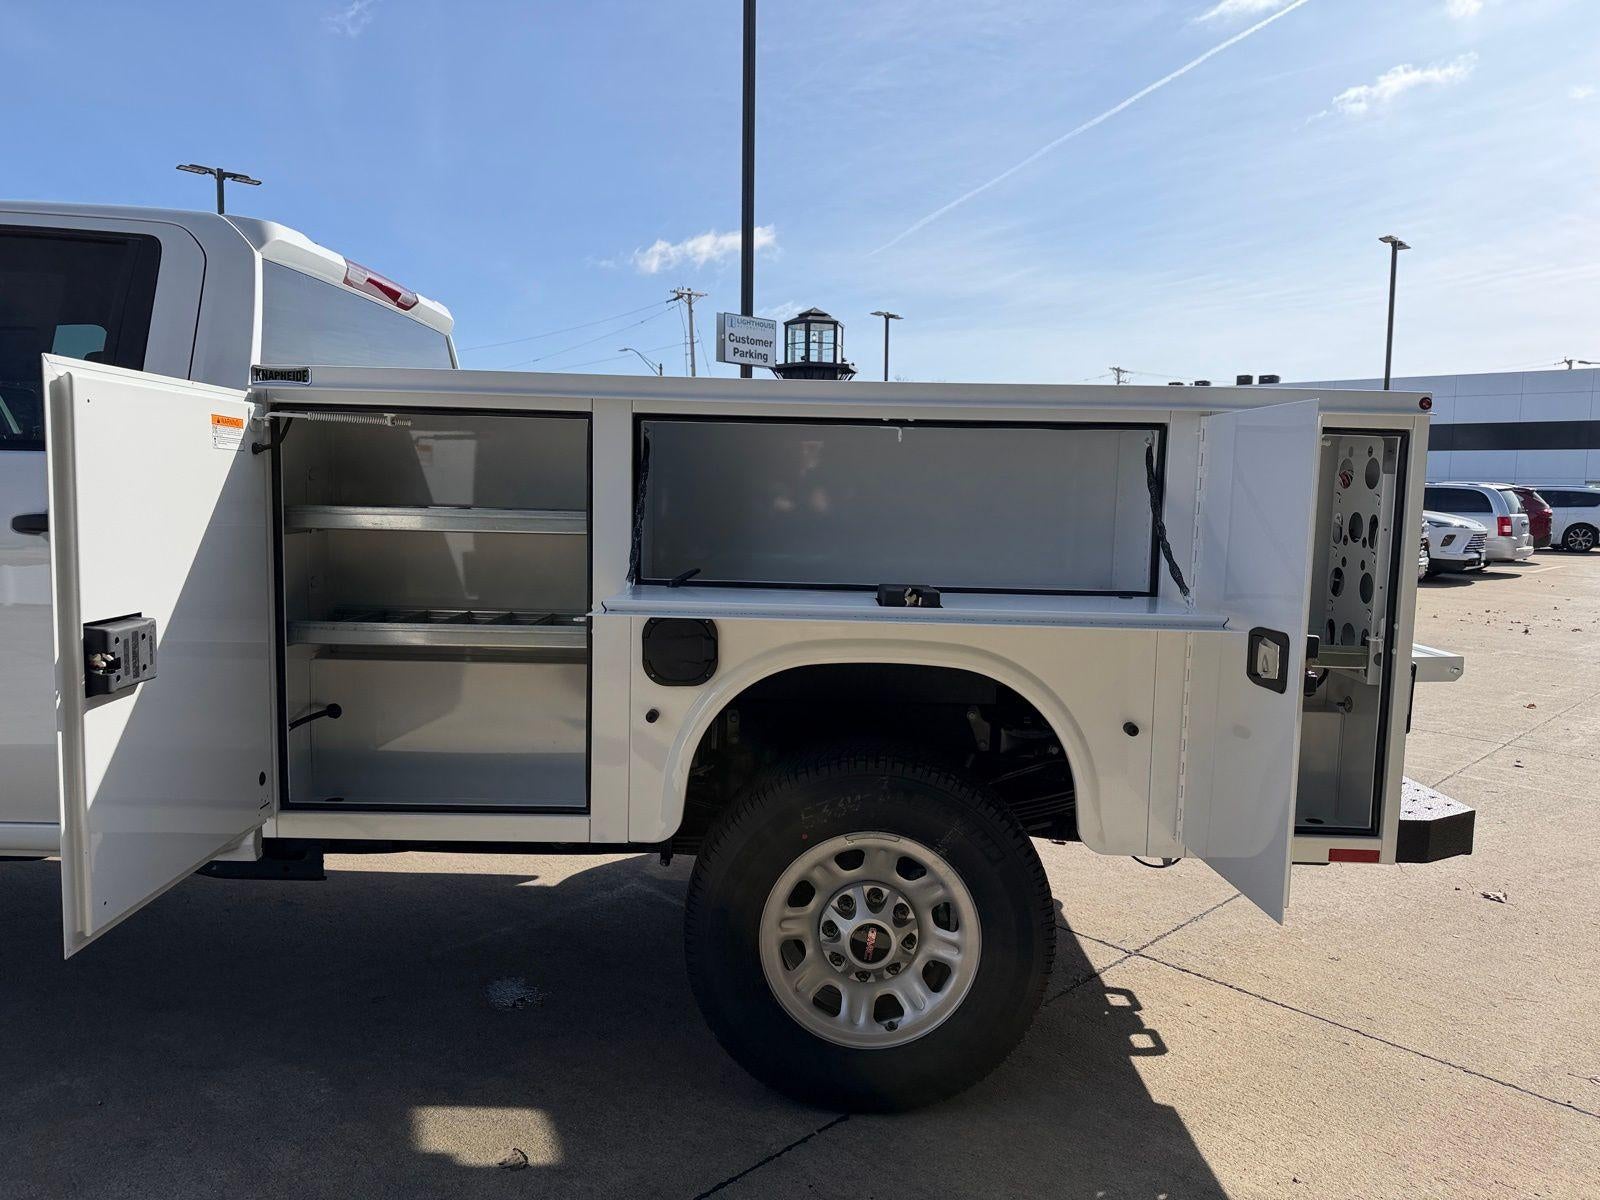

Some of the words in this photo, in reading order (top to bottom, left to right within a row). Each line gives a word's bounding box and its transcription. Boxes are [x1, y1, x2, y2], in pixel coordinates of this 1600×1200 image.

[736, 318, 775, 330] LIGHTHOUSE
[728, 333, 773, 348] Customer
[733, 347, 769, 363] Parking
[255, 369, 308, 383] KNAPHEIDE
